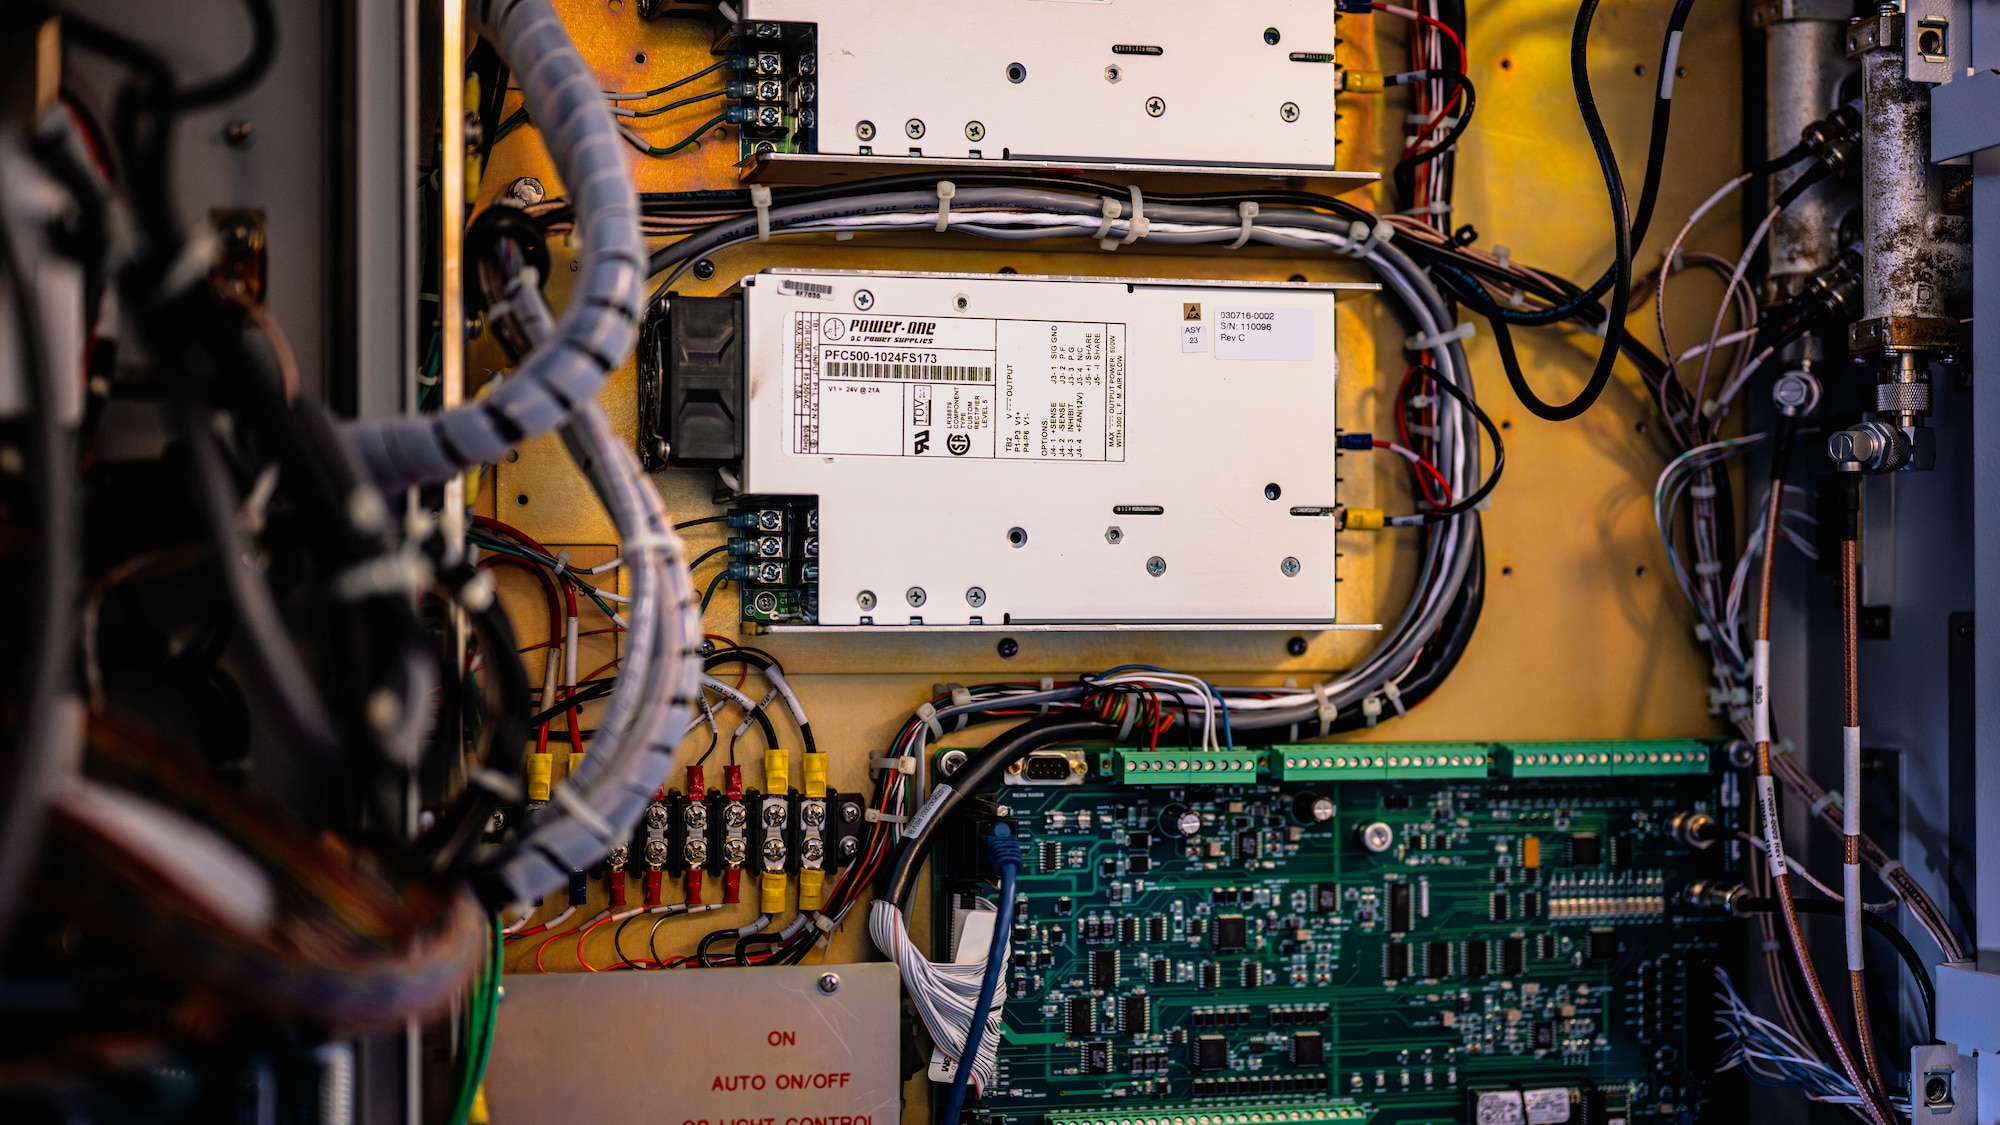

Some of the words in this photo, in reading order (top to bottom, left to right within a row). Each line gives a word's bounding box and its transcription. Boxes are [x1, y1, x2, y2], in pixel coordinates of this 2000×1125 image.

[1220, 312, 1275, 320] 030716-0002
[1220, 322, 1238, 331] S/N:
[1220, 334, 1236, 342] Rev
[1239, 334, 1245, 342] C
[825, 350, 937, 363] PFC500-1024FS173
[1005, 437, 1013, 452] TB2
[767, 1030, 795, 1046] ON
[711, 1075, 766, 1091] AUTO
[775, 1073, 851, 1090] ON/OFF
